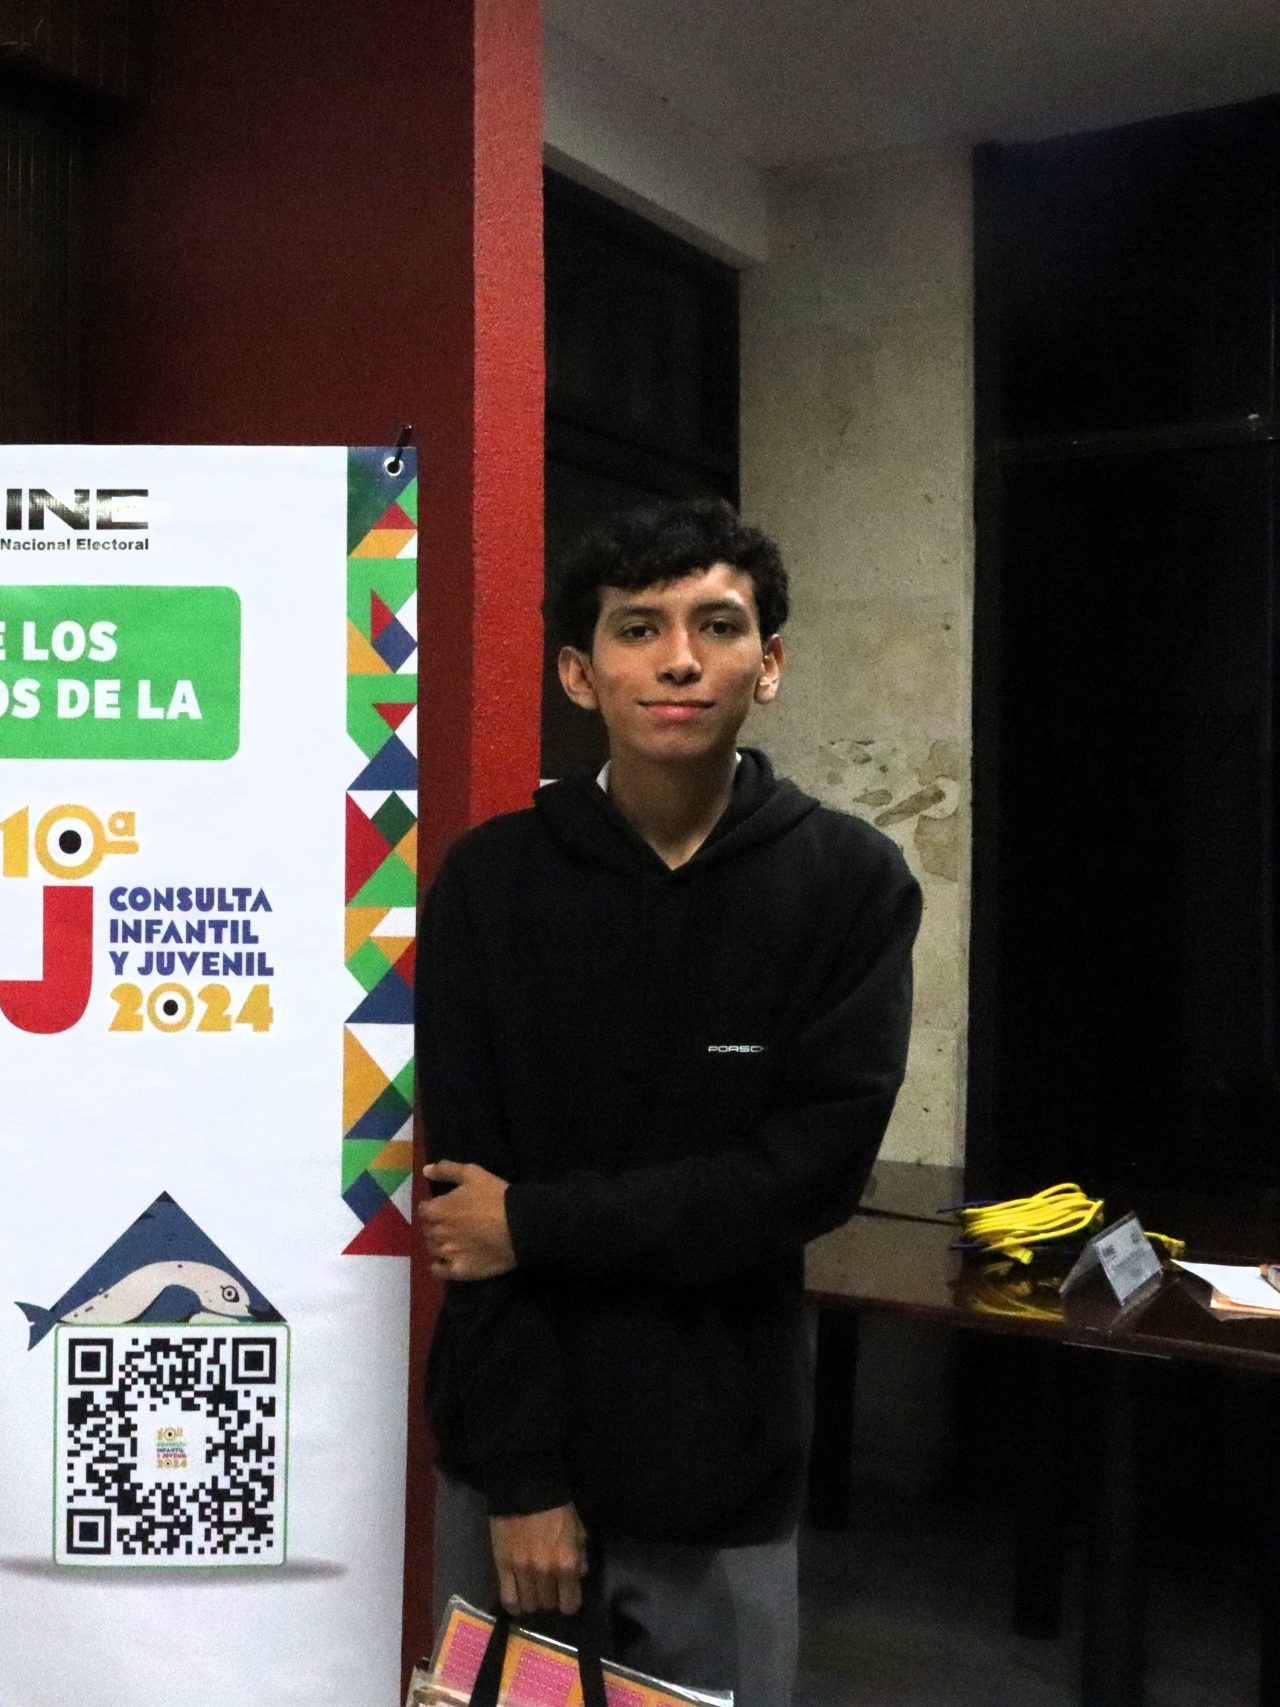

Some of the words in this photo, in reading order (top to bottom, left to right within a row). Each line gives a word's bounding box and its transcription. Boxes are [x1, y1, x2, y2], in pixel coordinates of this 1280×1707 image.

[5, 488, 149, 531] INE
[0, 538, 71, 551] Nacional
[76, 538, 150, 551] Electoral
[21, 619, 118, 663] LOS
[56, 678, 122, 720] DE
[136, 679, 203, 721] LA
[109, 886, 273, 912] CONSULTA
[109, 919, 259, 944] INFANTIL
[110, 951, 129, 976] Y
[137, 951, 274, 976] JUVENIL
[108, 982, 274, 1033] 2024
[708, 1045, 766, 1053] PORSC
